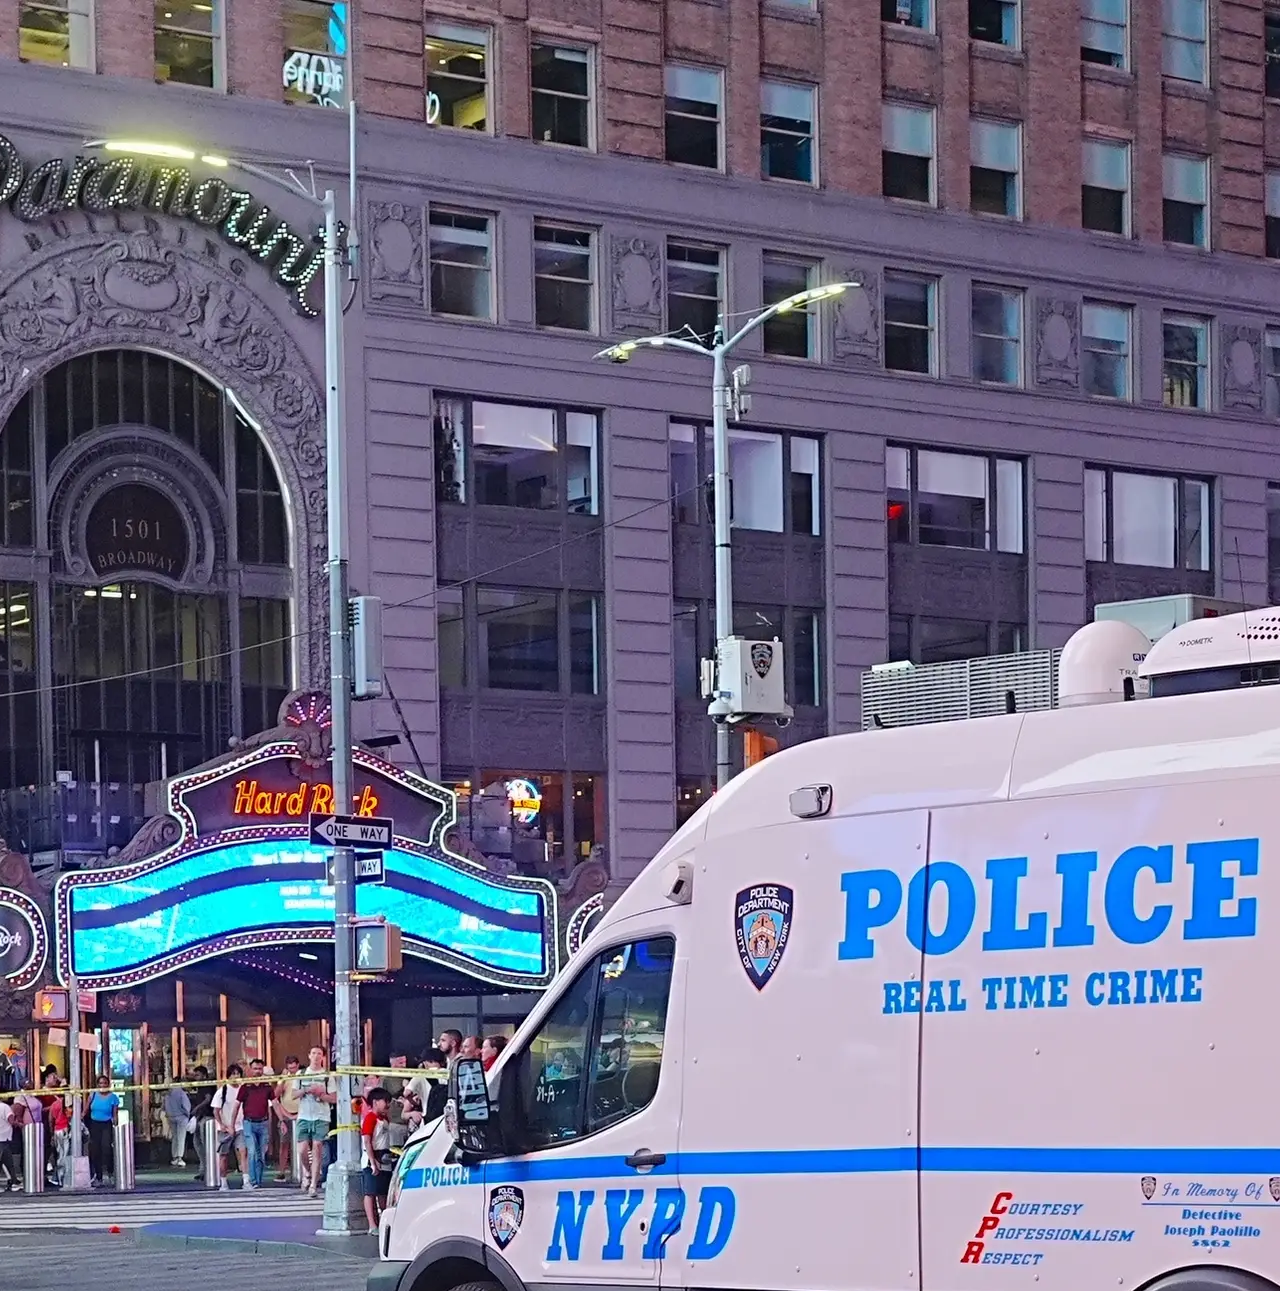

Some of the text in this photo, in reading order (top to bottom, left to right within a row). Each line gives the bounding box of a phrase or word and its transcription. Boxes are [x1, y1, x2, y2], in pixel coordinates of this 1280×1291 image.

[111, 517, 160, 540] 1501
[98, 549, 176, 572] BROADWAY
[235, 780, 379, 818] Hard Rk
[326, 824, 385, 840] ONE WAY
[360, 860, 379, 873] WAY
[750, 887, 778, 899] POLICE
[838, 838, 1260, 961] POLICE
[738, 898, 789, 918] DEPARTMENT
[736, 929, 746, 953] CITY
[767, 922, 789, 973] NEW YORK
[882, 968, 1203, 1014] REAL TIME CRIME
[423, 1166, 469, 1188] POLICE
[990, 1191, 1084, 1215] COURTESY
[1161, 1182, 1263, 1202] In Memory Of
[546, 1185, 736, 1261] NYPD
[1181, 1208, 1243, 1221] Detective
[974, 1216, 1136, 1242] PROFESSIONALISM
[1163, 1224, 1261, 1238] Joseph Paolillo
[959, 1241, 1044, 1265] RESPECT
